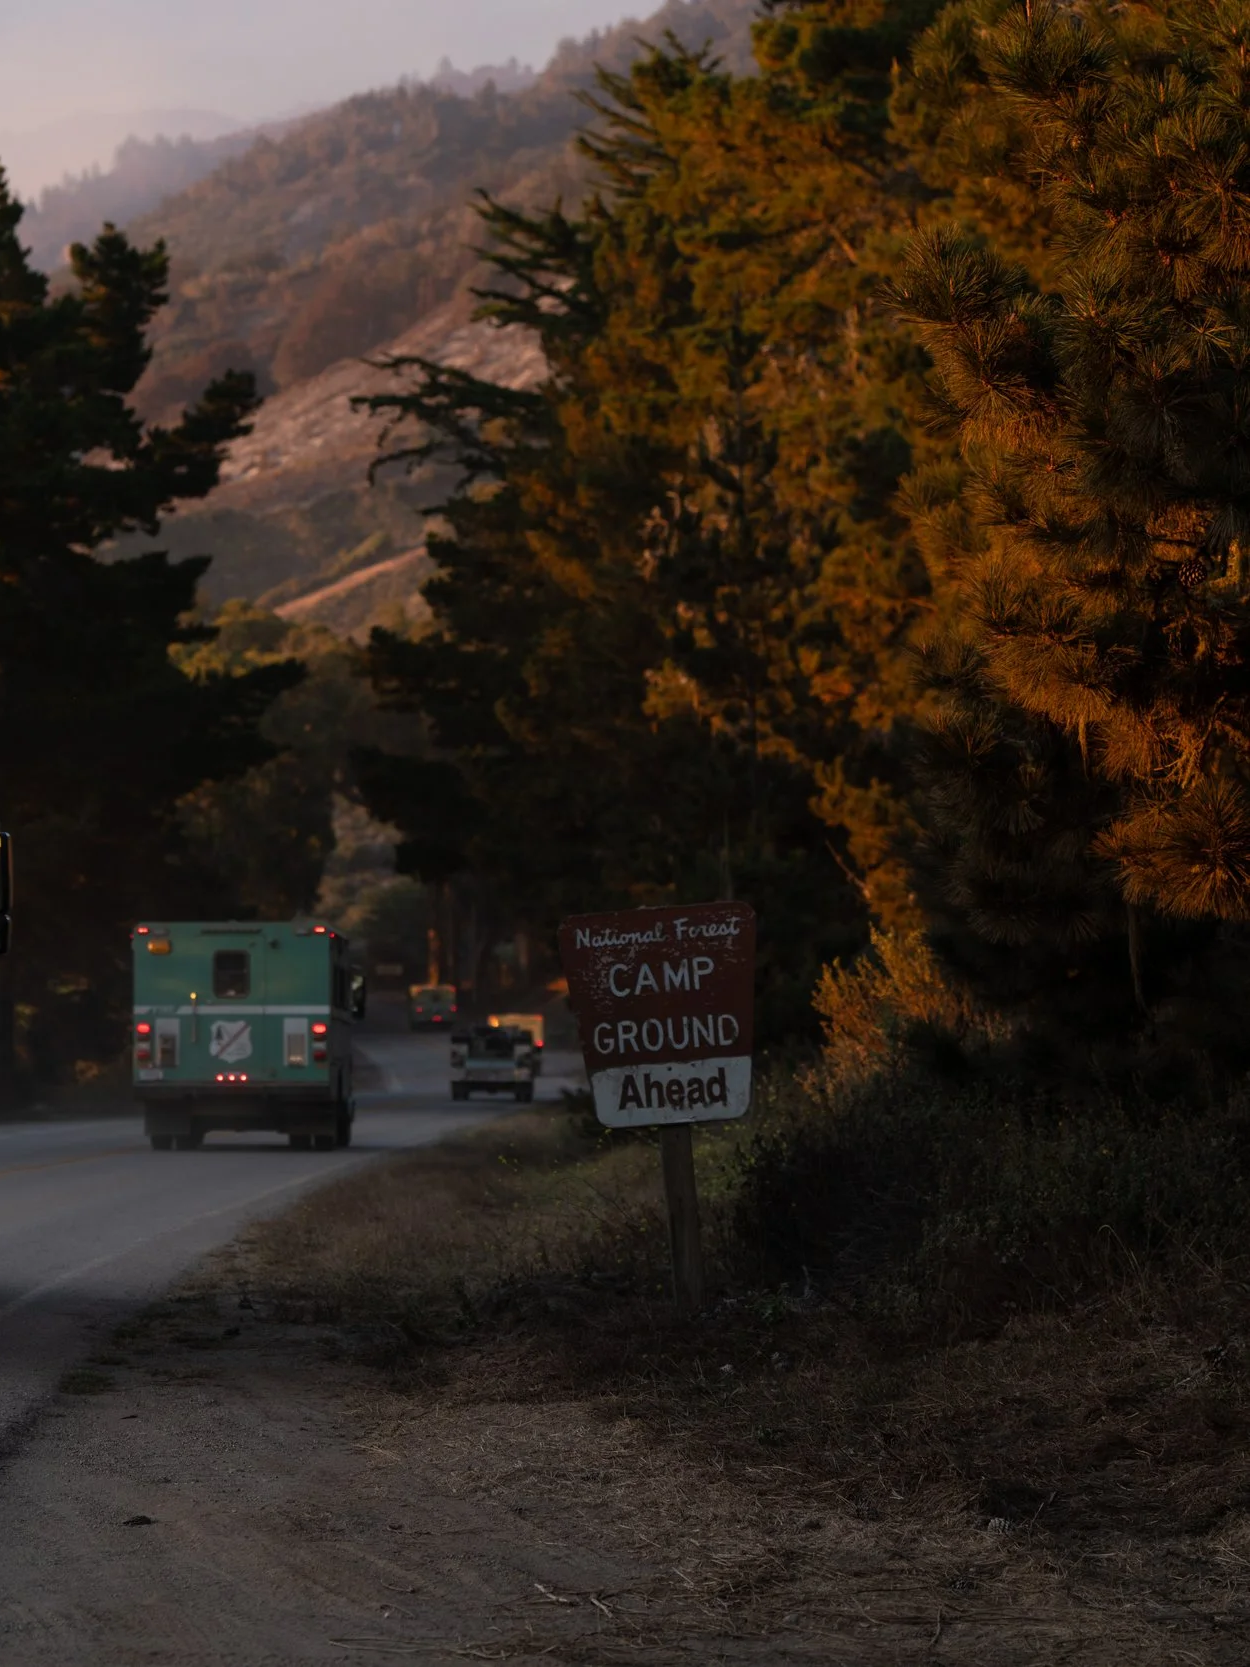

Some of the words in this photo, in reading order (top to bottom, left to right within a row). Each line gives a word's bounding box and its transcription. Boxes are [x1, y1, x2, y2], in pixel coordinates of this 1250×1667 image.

[576, 922, 667, 949] National
[674, 917, 740, 940] Forest
[609, 956, 714, 997] CAMP
[593, 1014, 739, 1054] GROUND
[619, 1067, 728, 1111] Ahead
